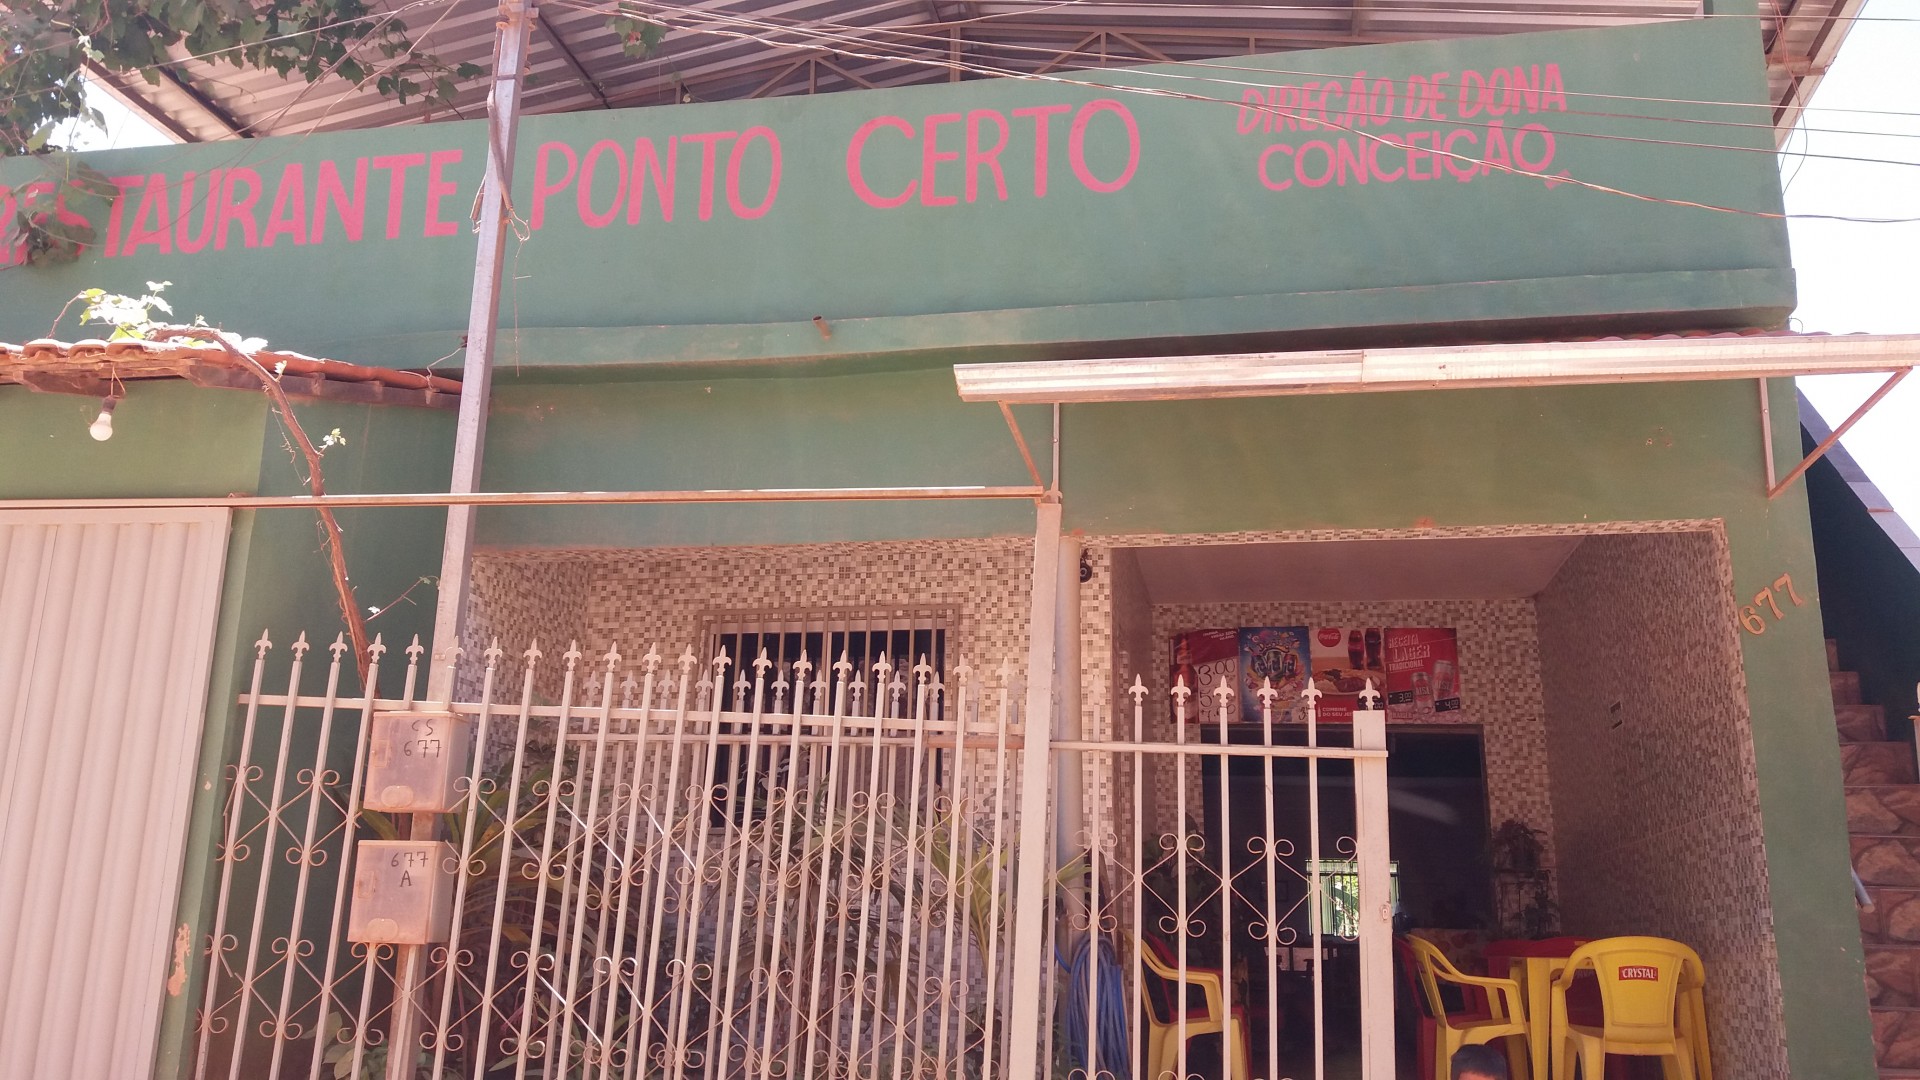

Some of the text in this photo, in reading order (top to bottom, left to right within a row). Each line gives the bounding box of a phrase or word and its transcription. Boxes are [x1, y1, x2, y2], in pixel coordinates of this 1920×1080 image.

[1404, 72, 1451, 123] DE
[1457, 63, 1568, 119] DONA
[530, 125, 783, 231] PONTO
[846, 98, 1141, 210] CERTO
[1738, 572, 1804, 636] 677
[1392, 643, 1431, 663] LAGER
[1388, 659, 1425, 671] TRADICIONAL
[403, 739, 442, 759] 677
[390, 850, 429, 868] 677
[400, 869, 413, 888] A
[1622, 967, 1655, 979] CRYSTAL
